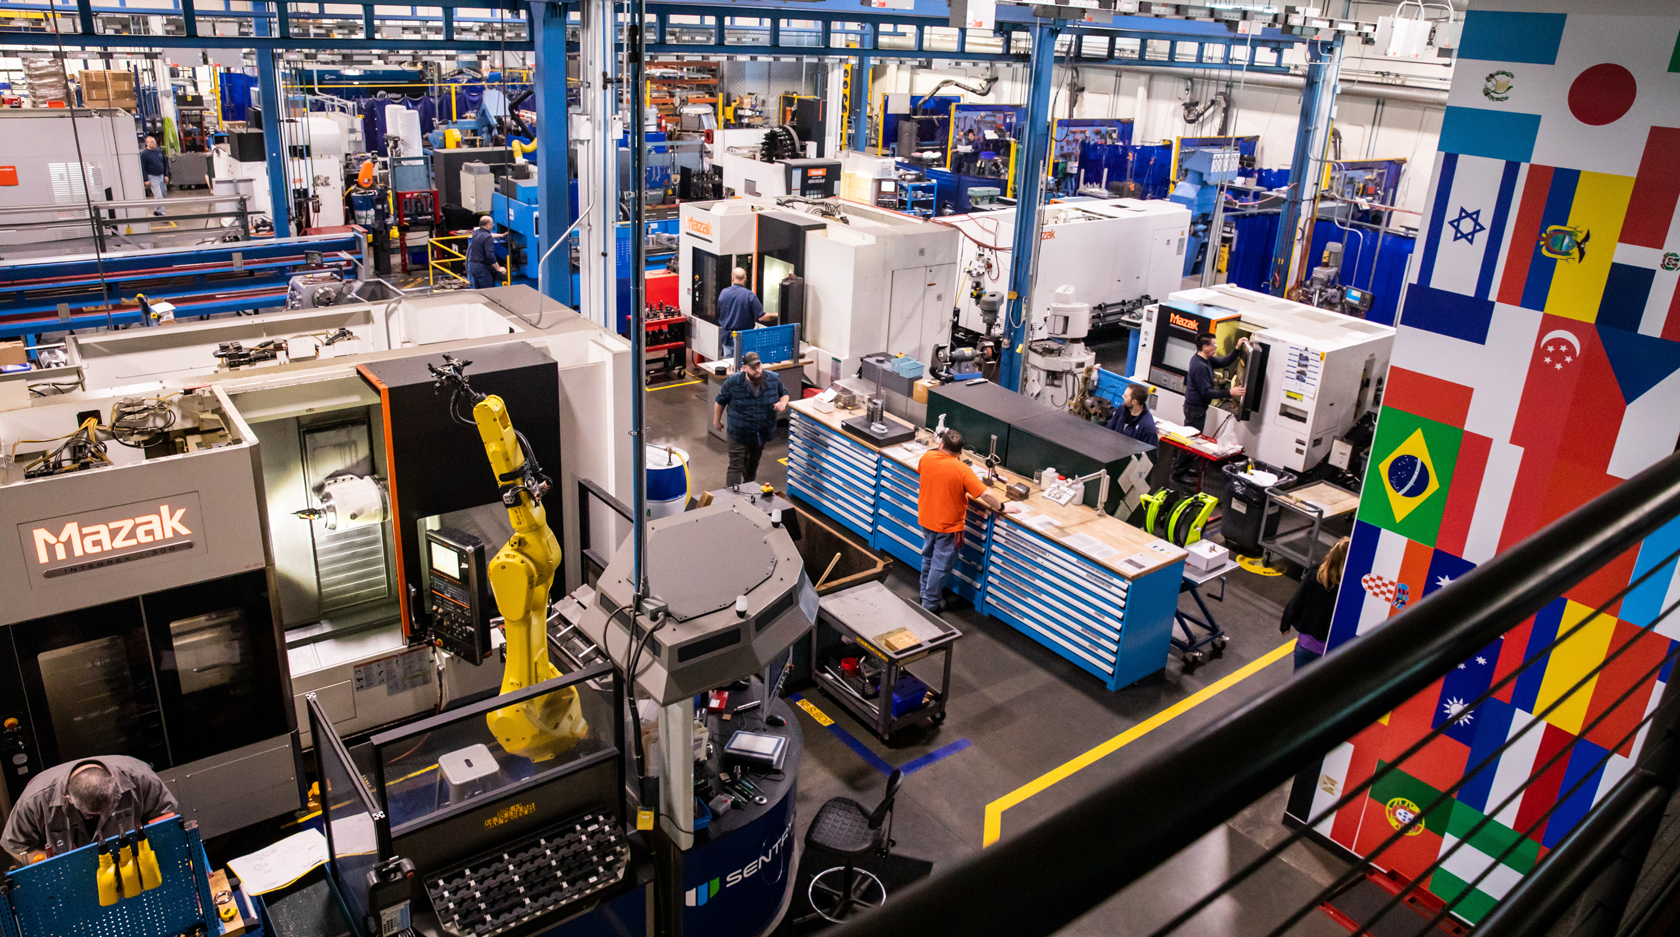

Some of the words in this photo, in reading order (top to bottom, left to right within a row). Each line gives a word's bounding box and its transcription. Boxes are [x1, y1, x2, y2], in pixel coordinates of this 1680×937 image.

[684, 214, 713, 237] Mazak
[1041, 229, 1056, 241] zak
[1169, 312, 1199, 332] Mazak
[32, 504, 193, 565] Mazak
[64, 556, 131, 574] INTEGREX
[807, 706, 832, 725] JOBS
